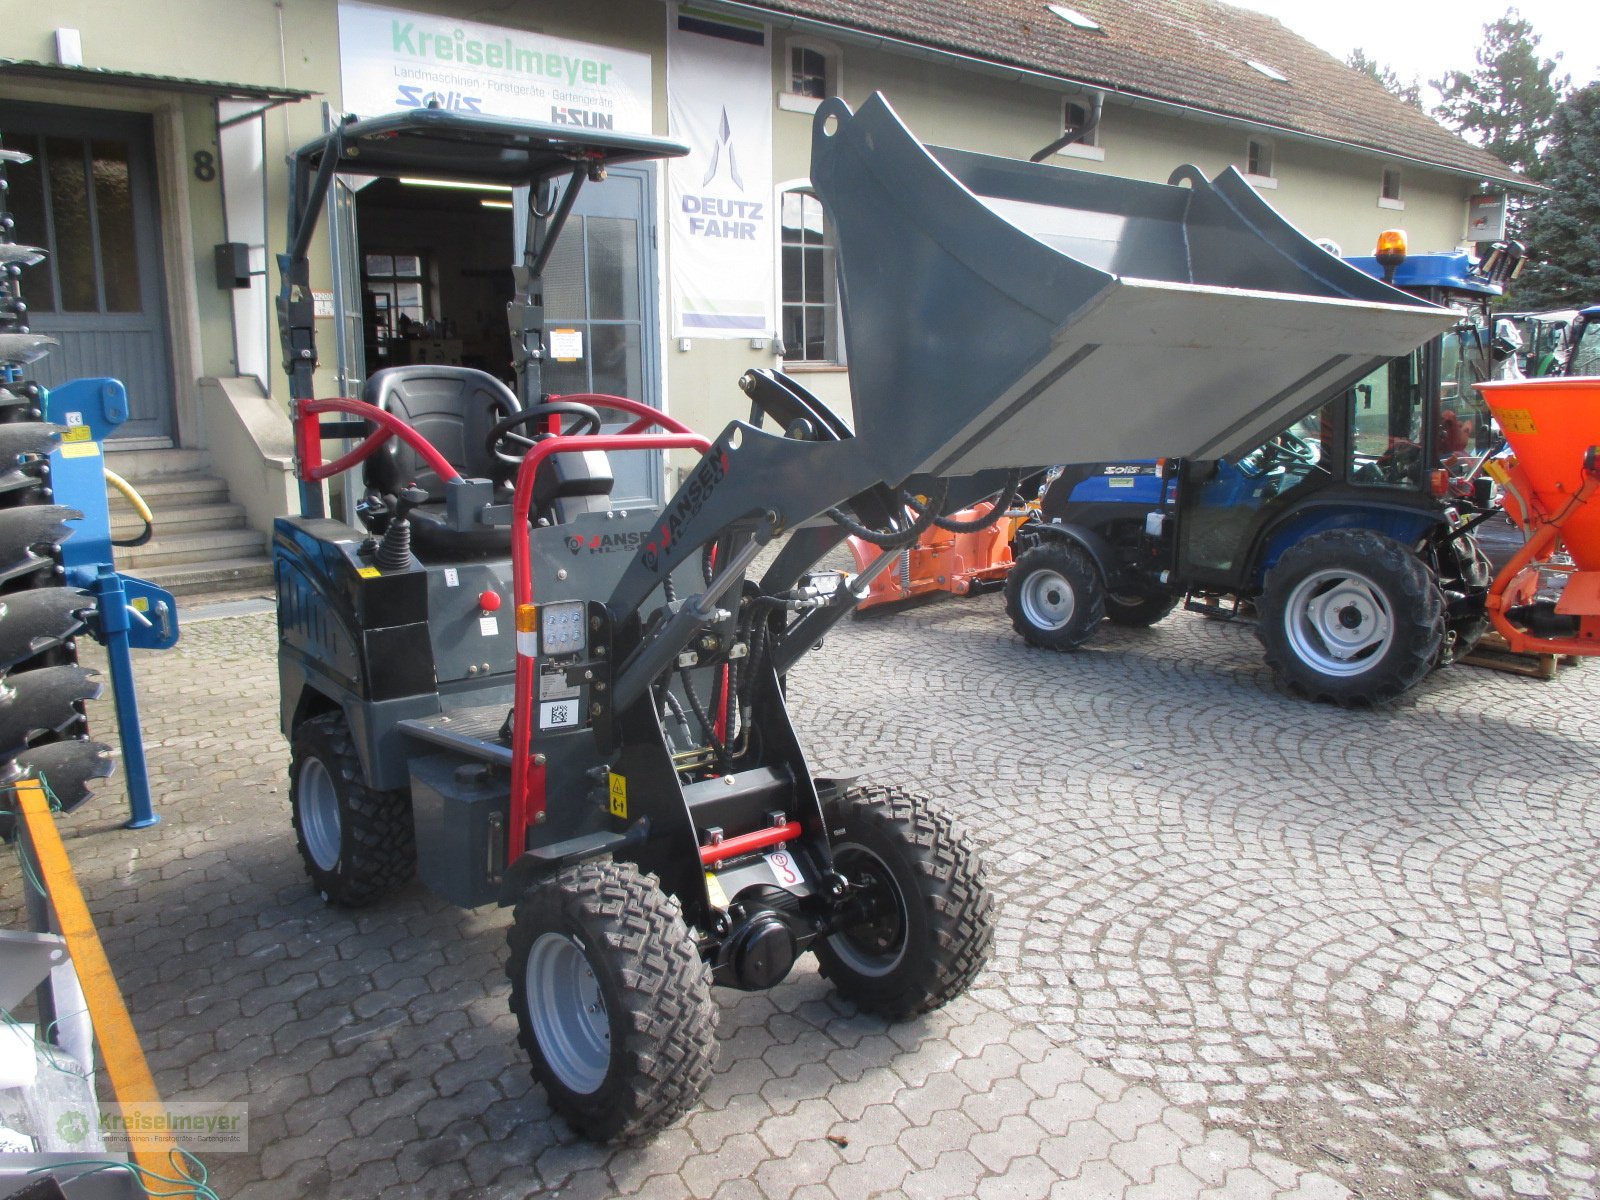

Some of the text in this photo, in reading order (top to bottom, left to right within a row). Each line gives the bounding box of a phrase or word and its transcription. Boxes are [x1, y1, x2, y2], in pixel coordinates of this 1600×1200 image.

[391, 19, 613, 86] Kreiselmeyer
[394, 65, 613, 108] Landmaschinen Forstgeräte Gartengeräte
[193, 150, 215, 182] 8
[681, 194, 764, 220] DEUTZ
[689, 216, 756, 241] FAHR
[661, 446, 723, 549] JANSEN
